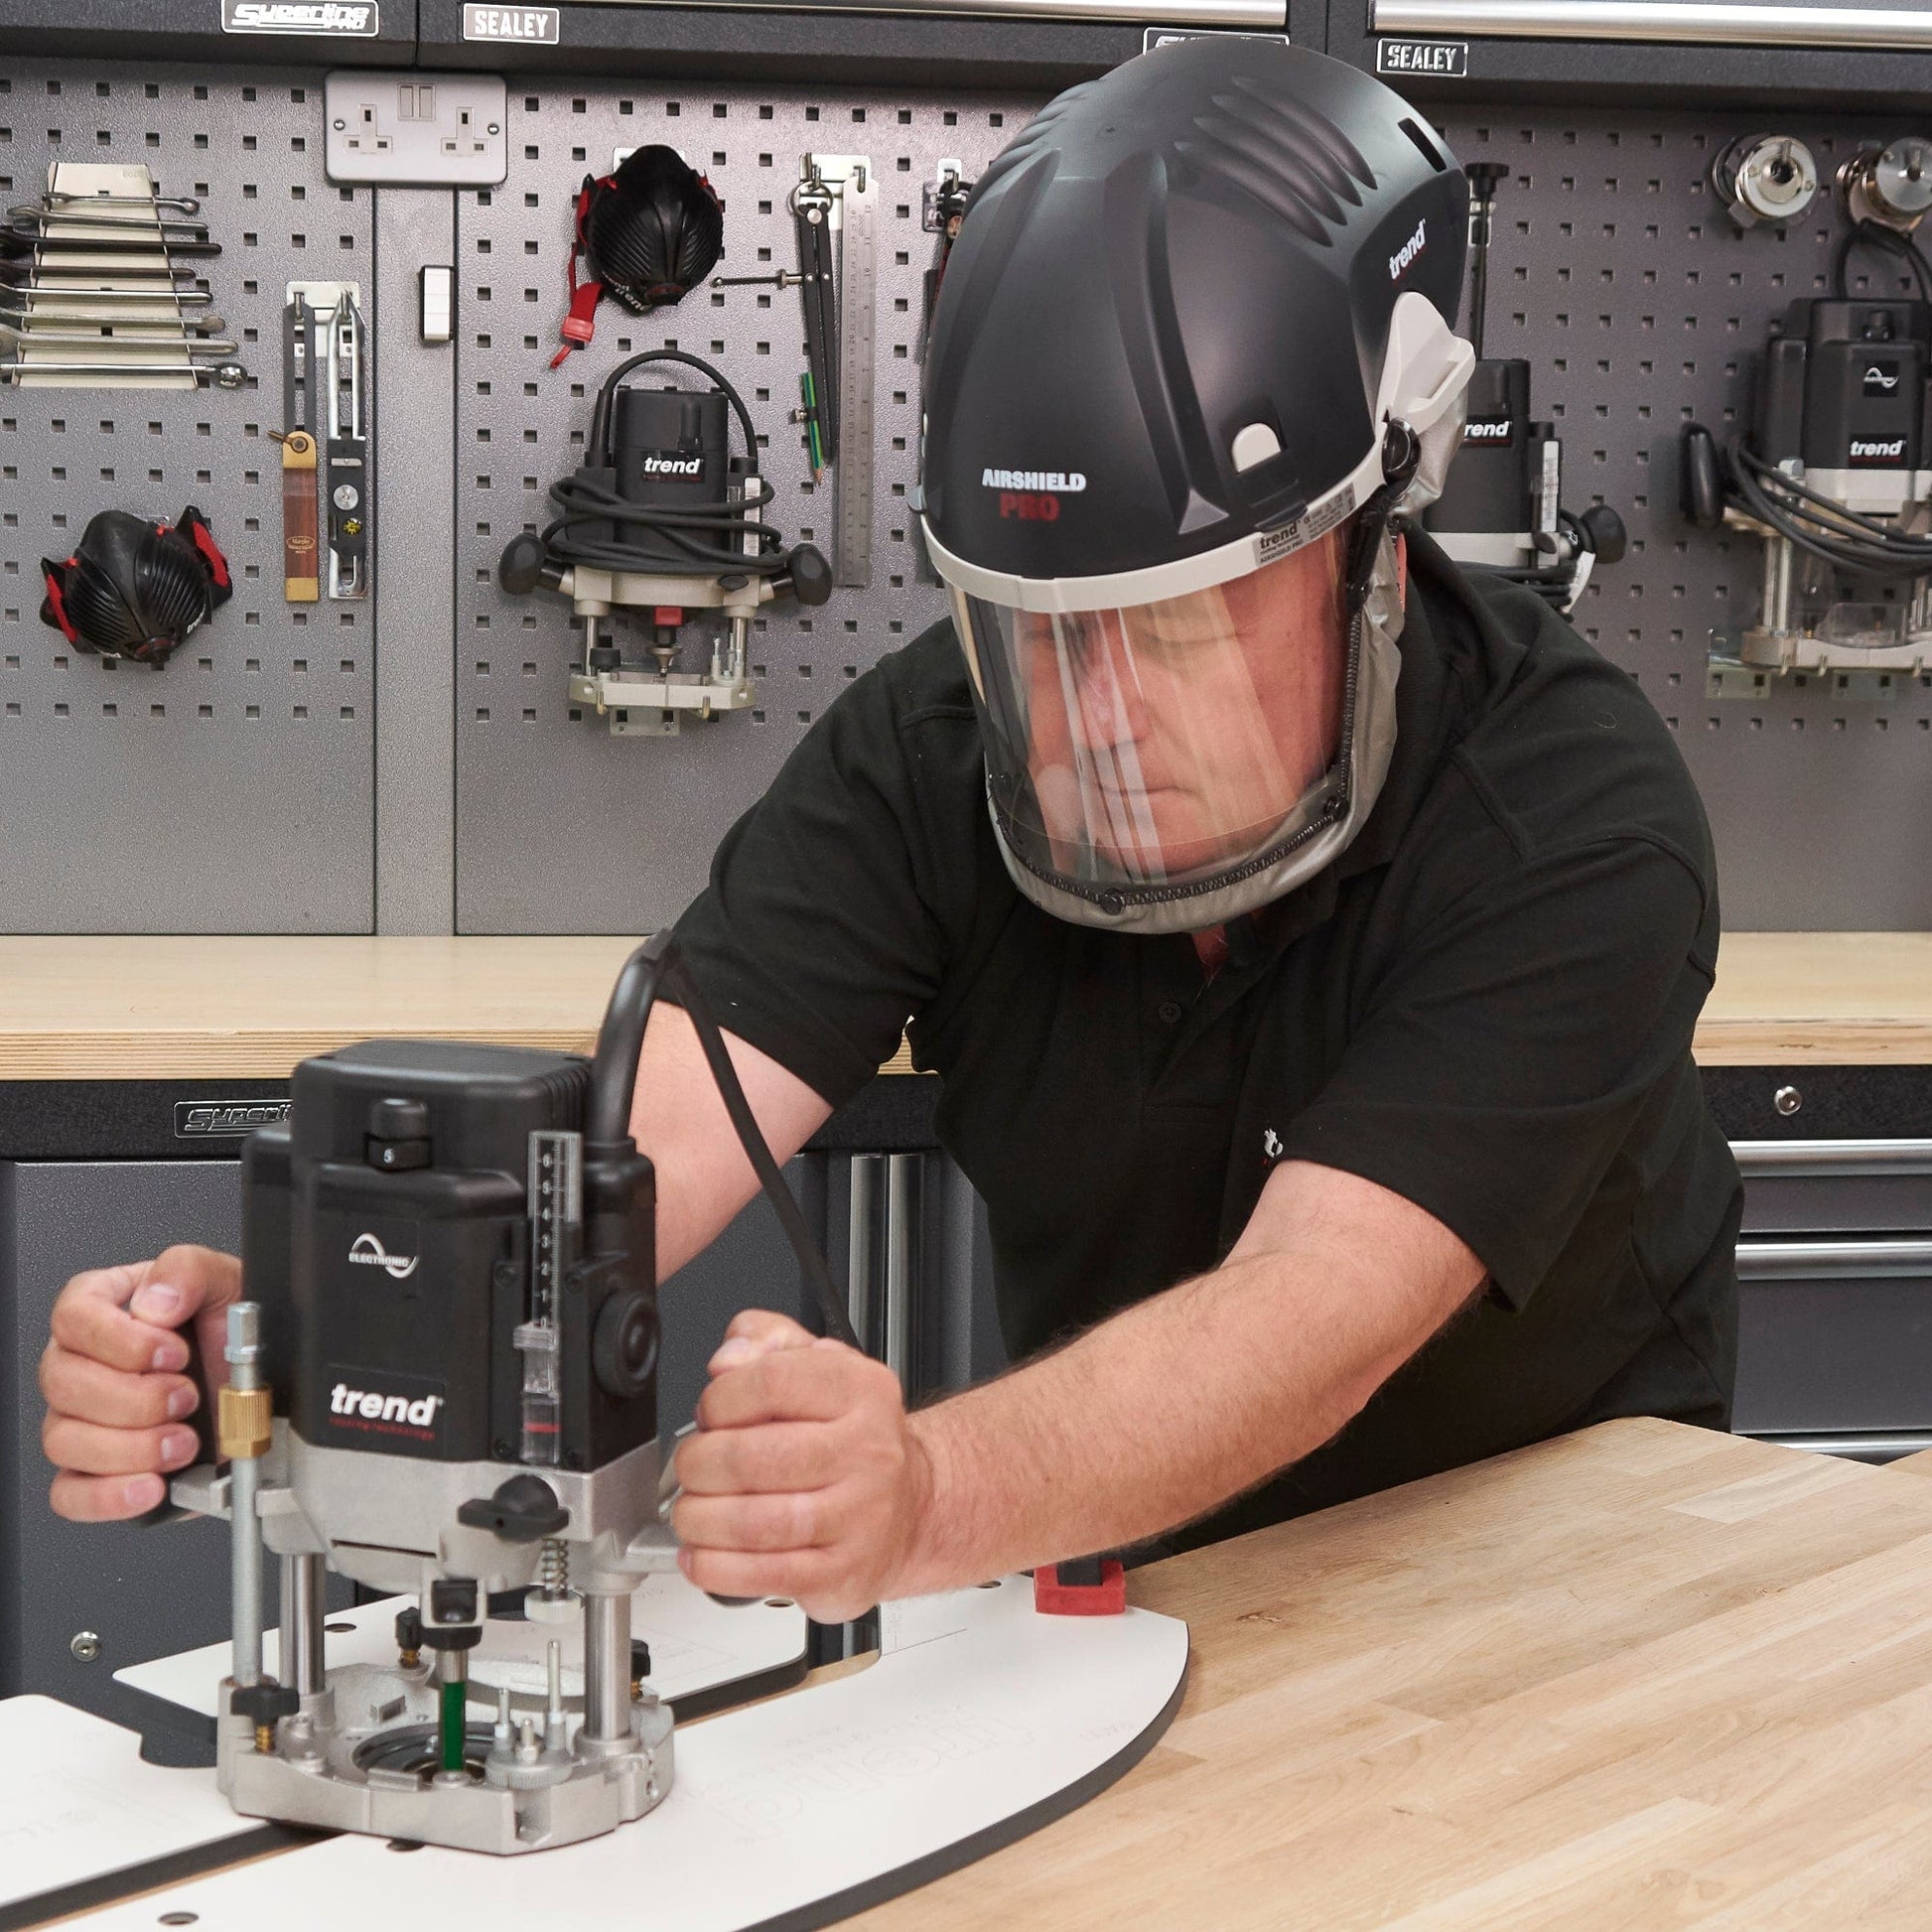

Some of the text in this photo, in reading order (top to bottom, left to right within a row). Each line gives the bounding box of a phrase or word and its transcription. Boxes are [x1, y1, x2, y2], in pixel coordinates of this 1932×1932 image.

[231, 3, 370, 28] Superline
[475, 10, 549, 38] SEALEY
[1387, 45, 1457, 71] SEALEY
[1389, 220, 1426, 279] trend
[1464, 420, 1509, 438] rend
[1850, 439, 1903, 457] trend
[644, 457, 701, 474] trend
[982, 468, 1087, 492] AIRSHIELD
[1000, 491, 1060, 522] PRO
[1259, 521, 1299, 550] trend
[184, 1104, 293, 1132] Superli
[348, 1252, 412, 1268] ELECTRONIC
[331, 1383, 438, 1427] trend
